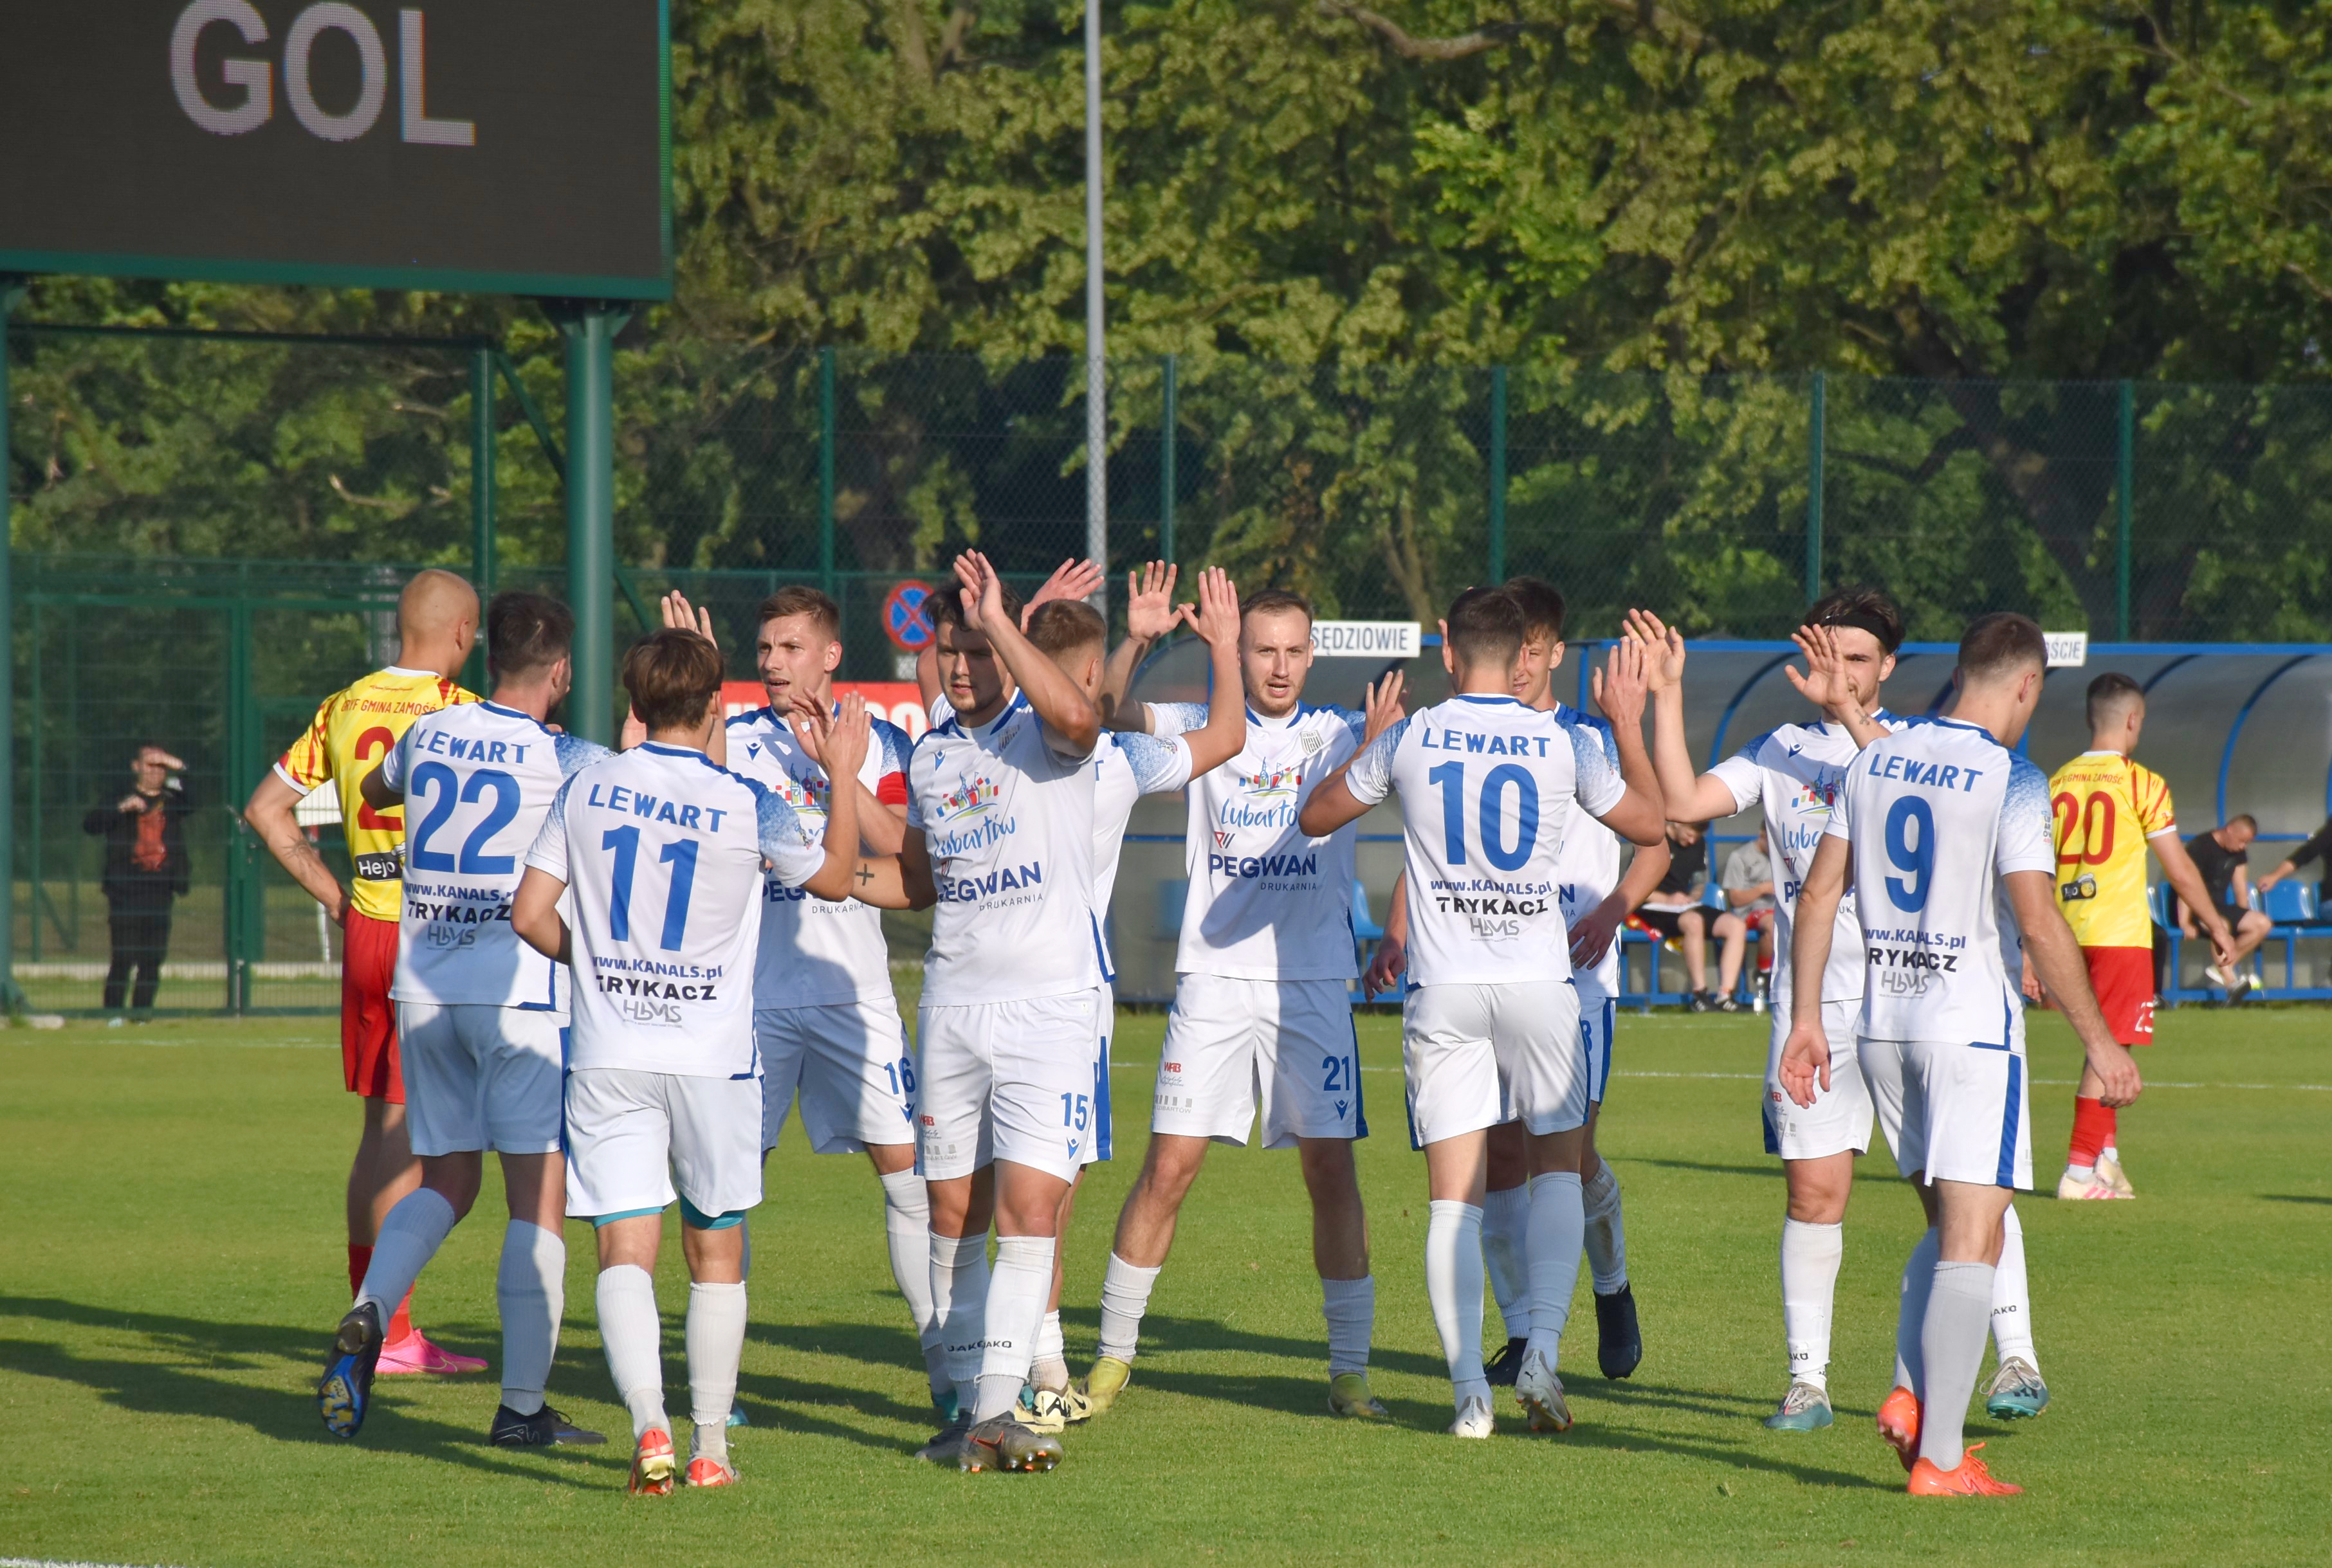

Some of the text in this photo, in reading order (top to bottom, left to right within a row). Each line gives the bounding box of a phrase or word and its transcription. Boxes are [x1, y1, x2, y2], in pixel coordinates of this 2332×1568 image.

[170, 0, 476, 146] GOL
[1311, 626, 1408, 655] SĘDZIOWIE
[2046, 636, 2081, 660] ŚCIE
[360, 700, 392, 713] GMINA
[415, 729, 531, 764] LEWART
[1422, 727, 1551, 758] LEWART
[1868, 754, 1983, 792] LEWART
[2068, 774, 2091, 782] GMINA
[411, 761, 521, 875] 22
[588, 783, 728, 833] LEWART
[1221, 798, 1298, 828] Lubartó
[1428, 760, 1539, 872] 10
[2052, 790, 2116, 866] 20
[358, 859, 395, 878] Hejo
[1209, 853, 1317, 879] PEGWAN
[1884, 795, 1935, 913] 9
[601, 824, 699, 952] 11
[979, 893, 1043, 911] DRUKARNIA
[1261, 882, 1317, 891] DRUKARNIA
[812, 902, 865, 914] DRUKARNIA
[1868, 947, 1958, 973] RYKACZ
[596, 975, 717, 1001] TRYKACZ
[884, 1057, 916, 1095] 16
[1322, 1055, 1351, 1091] 21
[1061, 1092, 1088, 1131] 15
